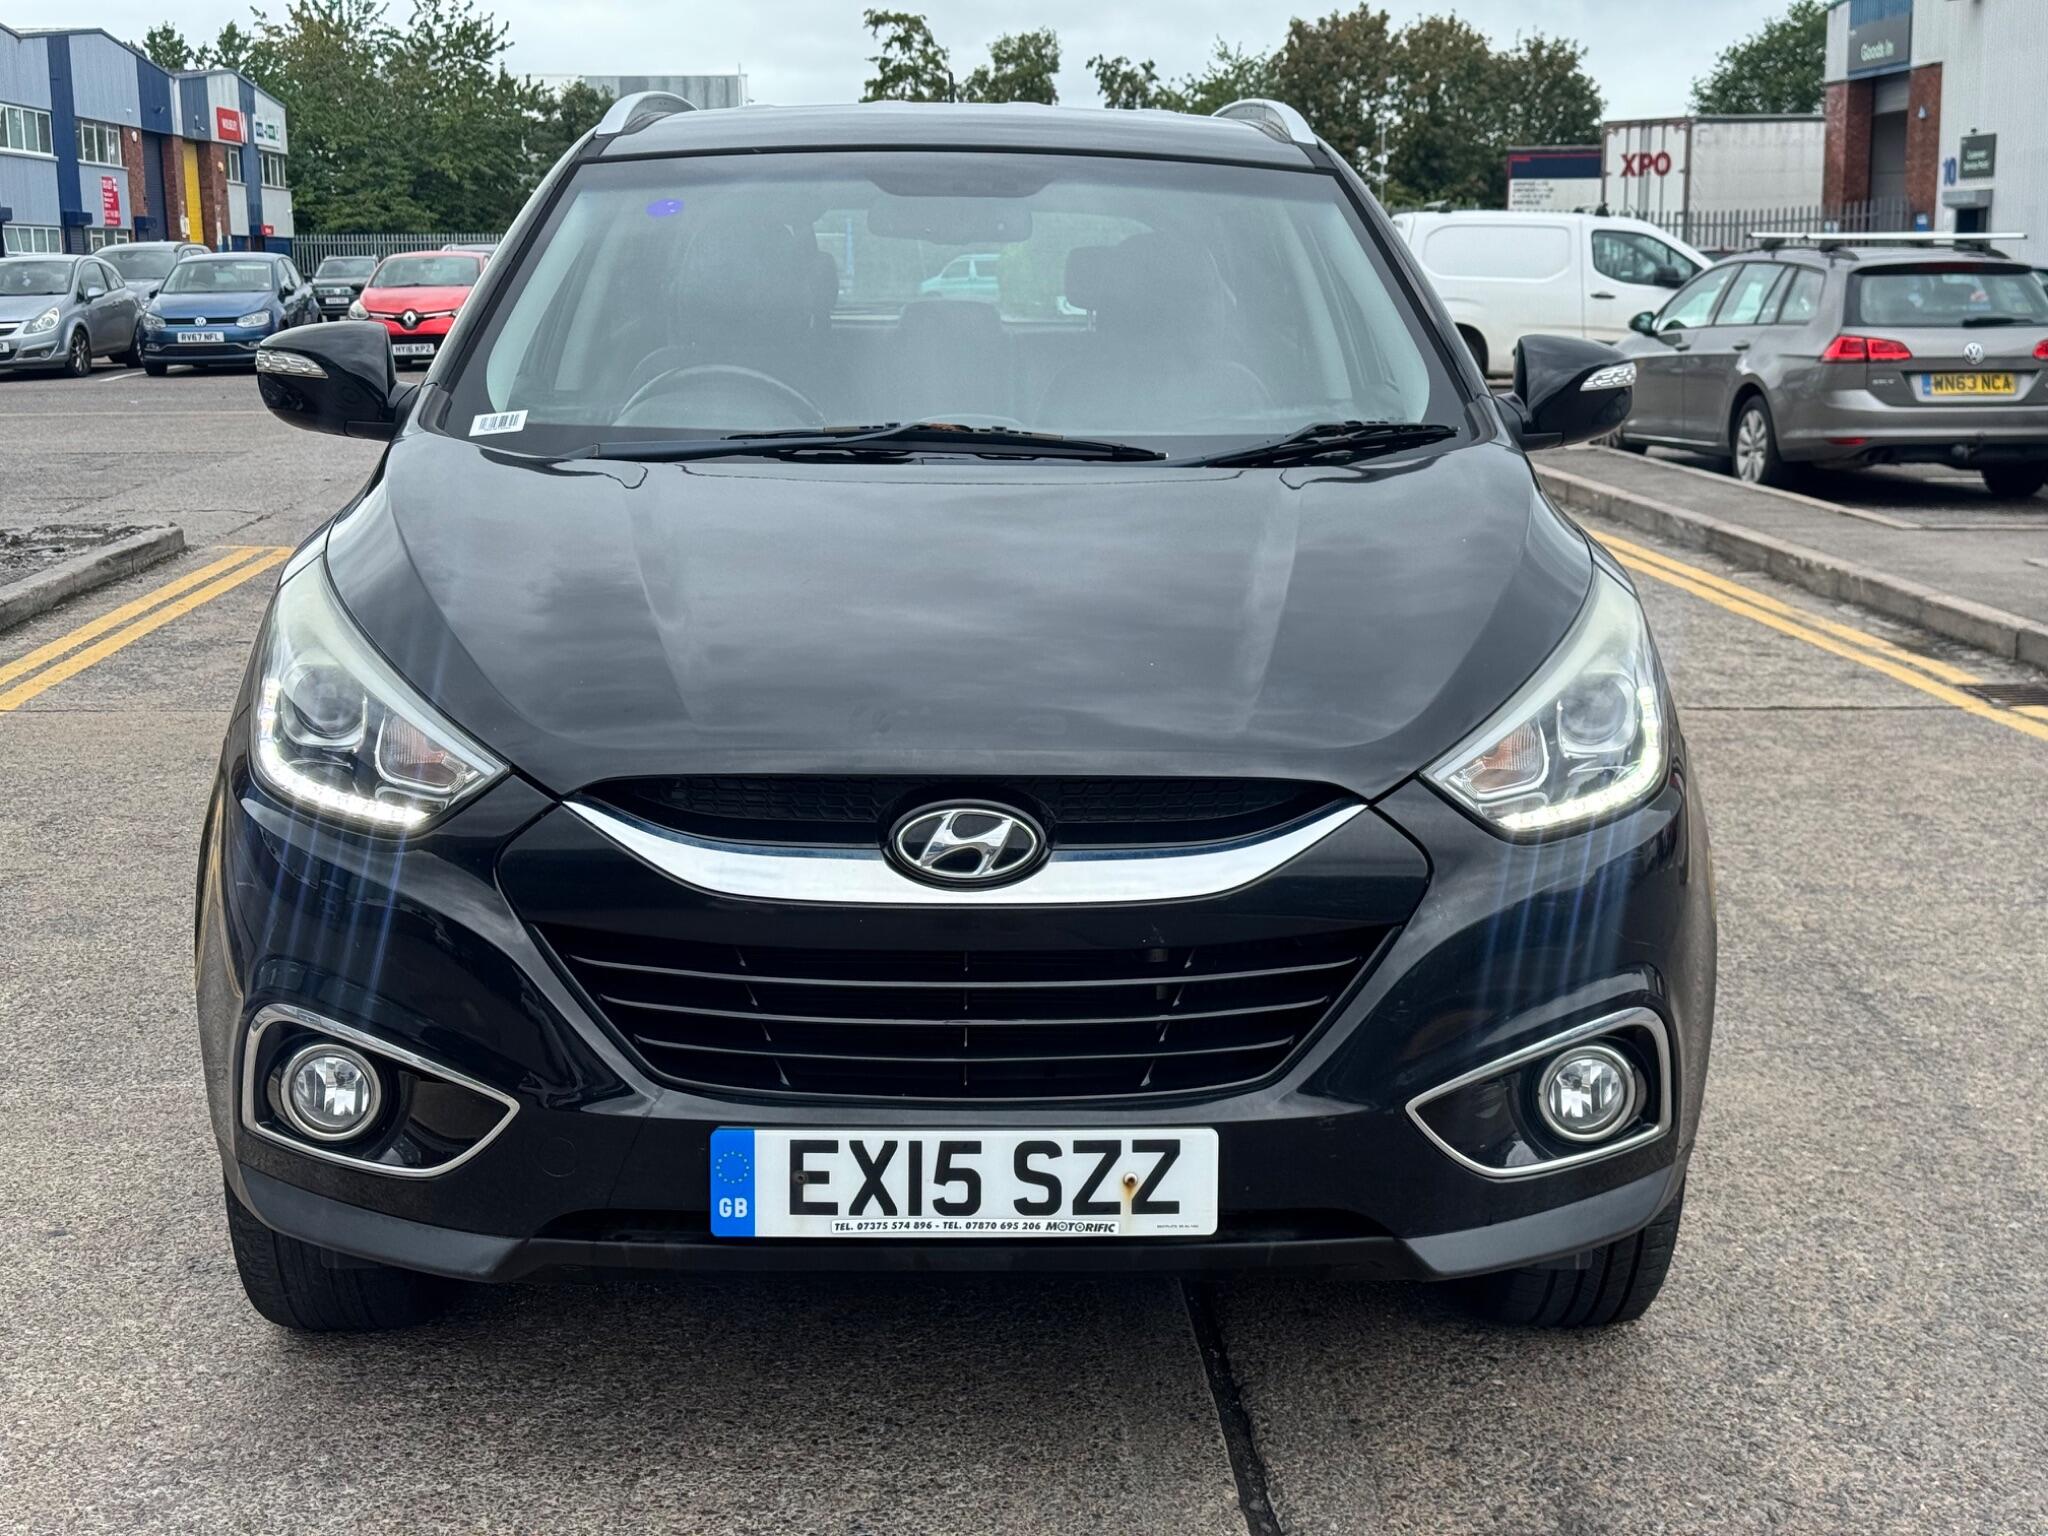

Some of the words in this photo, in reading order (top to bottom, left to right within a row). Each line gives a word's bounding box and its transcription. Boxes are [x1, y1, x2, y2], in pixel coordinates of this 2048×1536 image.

[1621, 151, 1671, 177] XPO
[1943, 157, 1956, 186] 10
[181, 333, 201, 341] RV67
[1934, 375, 1976, 391] WN63
[1981, 375, 2011, 390] NCA
[790, 1140, 981, 1217] EX15
[1013, 1139, 1181, 1217] SZZ
[719, 1197, 748, 1218] GB
[834, 1222, 854, 1231] TEL.
[856, 1221, 888, 1231] 07375
[891, 1221, 910, 1230] 574
[913, 1221, 932, 1230] 896
[943, 1221, 962, 1230] TEL.
[965, 1221, 997, 1230] 07870
[999, 1221, 1019, 1230] 695
[1021, 1221, 1041, 1230] 206
[1045, 1221, 1116, 1233] MOTORIFIC
